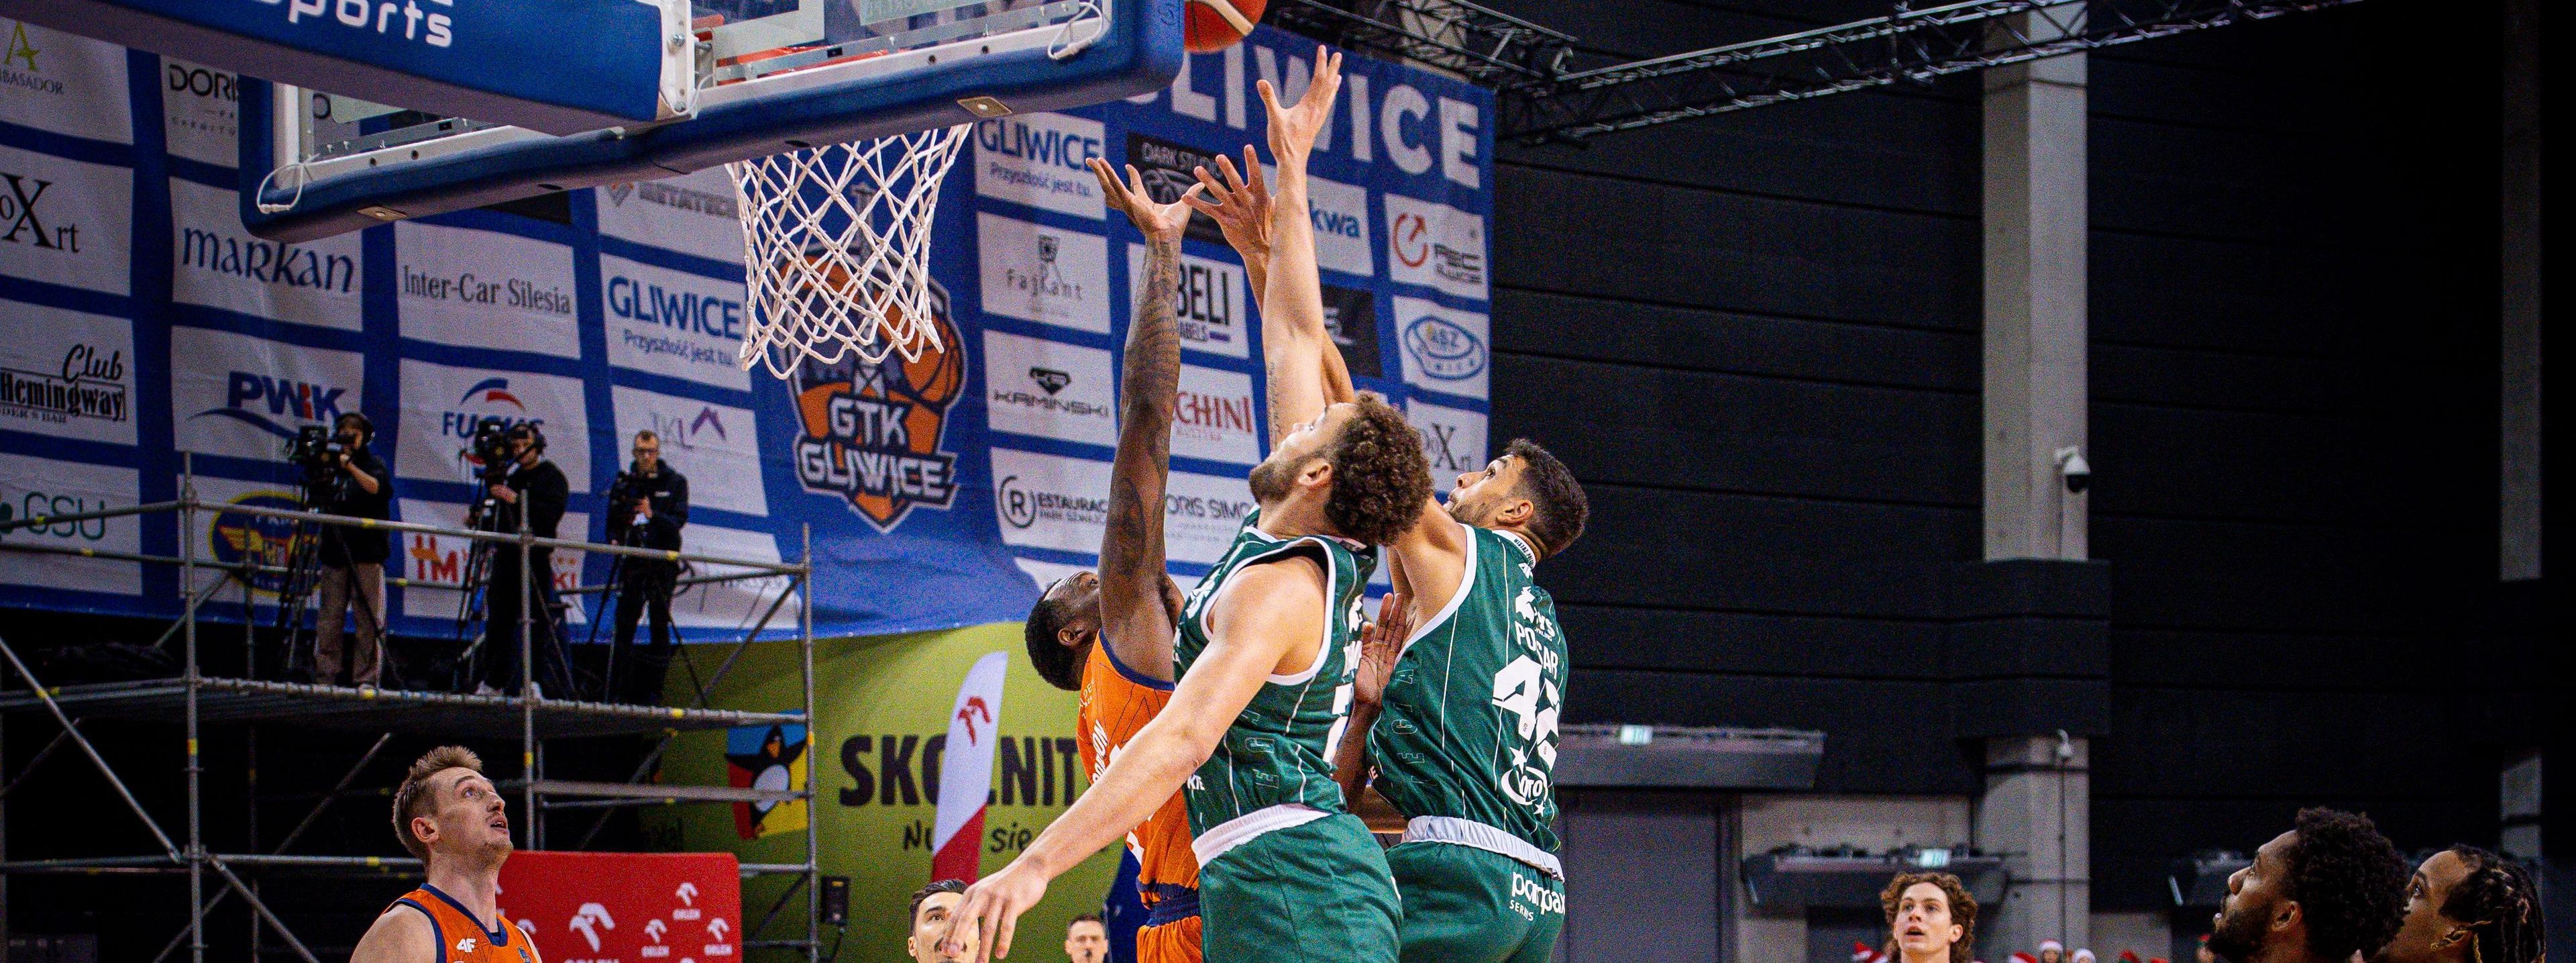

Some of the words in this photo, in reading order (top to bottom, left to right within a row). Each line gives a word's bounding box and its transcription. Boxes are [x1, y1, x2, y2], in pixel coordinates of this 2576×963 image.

[253, 0, 451, 47] ports
[168, 64, 239, 102] DORI
[977, 119, 1099, 172] GLIWICE
[403, 264, 500, 305] Inter-Car
[507, 276, 572, 315] Silesia
[608, 276, 743, 341] GLIWICE
[62, 344, 123, 383] Club
[0, 372, 123, 421] Hemingway
[830, 397, 906, 445] GTK
[800, 442, 947, 498] GLIWICE
[23, 491, 105, 540] GSU
[839, 735, 1078, 806] SKONIT
[456, 937, 476, 953] 4F
